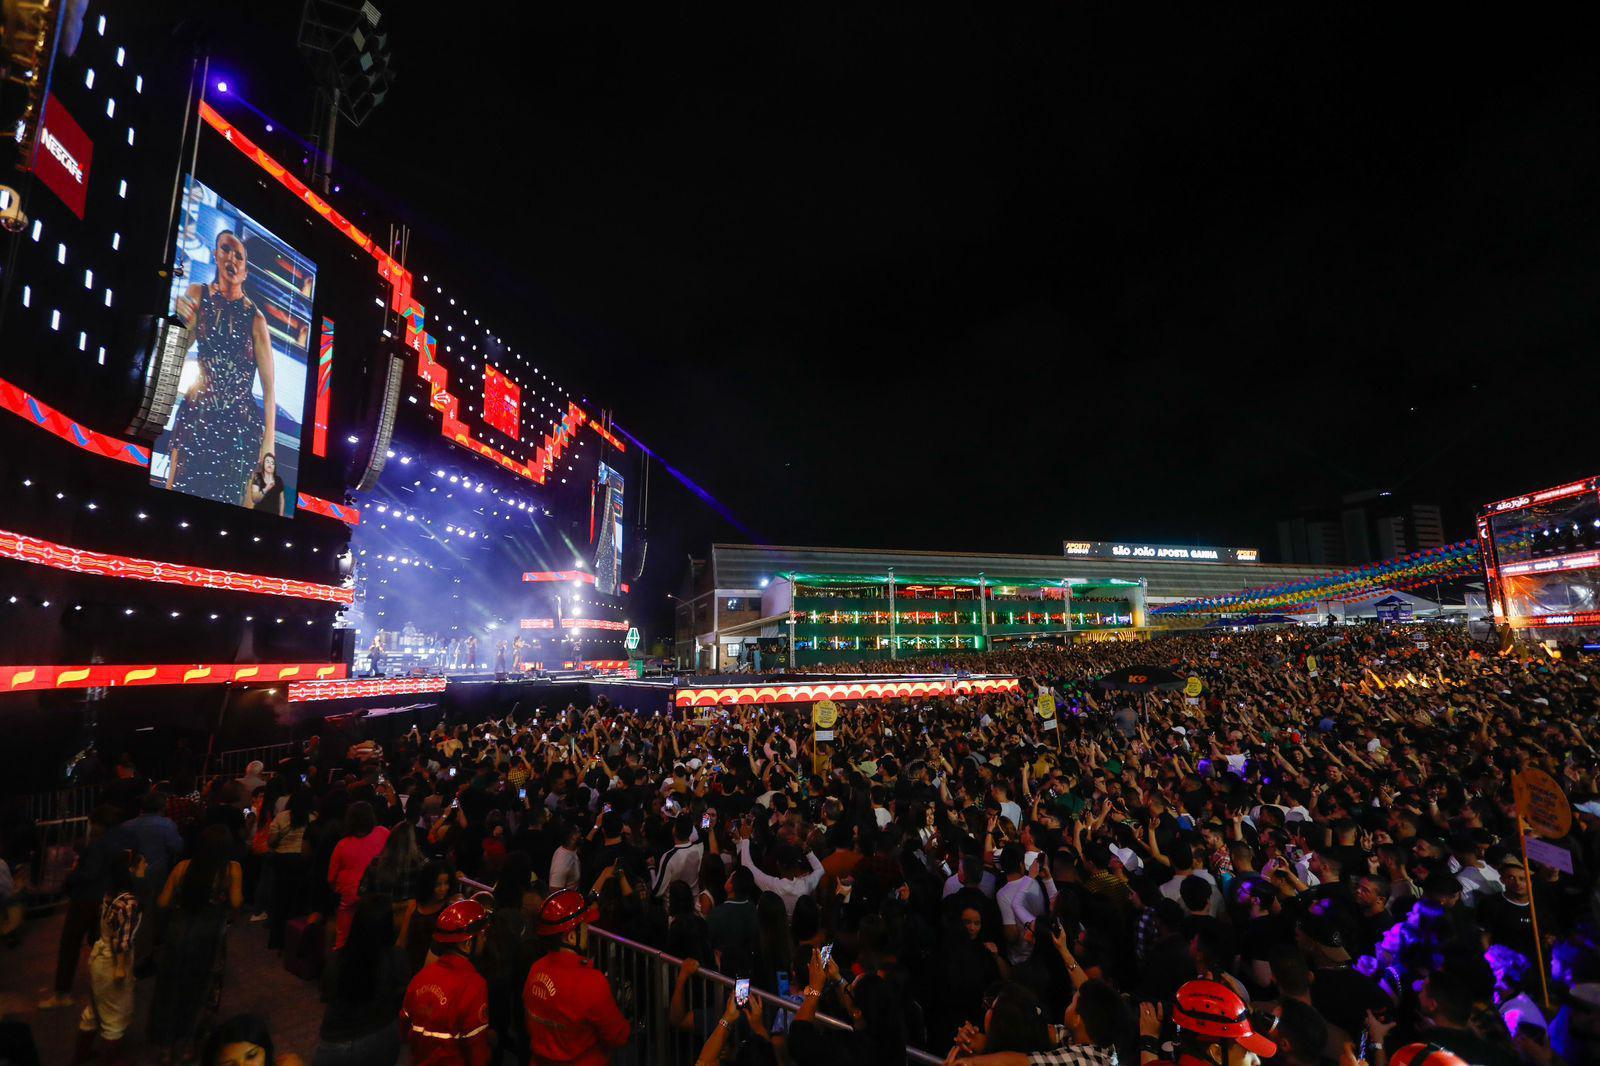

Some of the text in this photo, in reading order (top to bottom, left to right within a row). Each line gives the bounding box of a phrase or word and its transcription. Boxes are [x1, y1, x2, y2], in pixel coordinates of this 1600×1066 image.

[1112, 545, 1218, 559] SÃO JOÃO APOSTA GANHA
